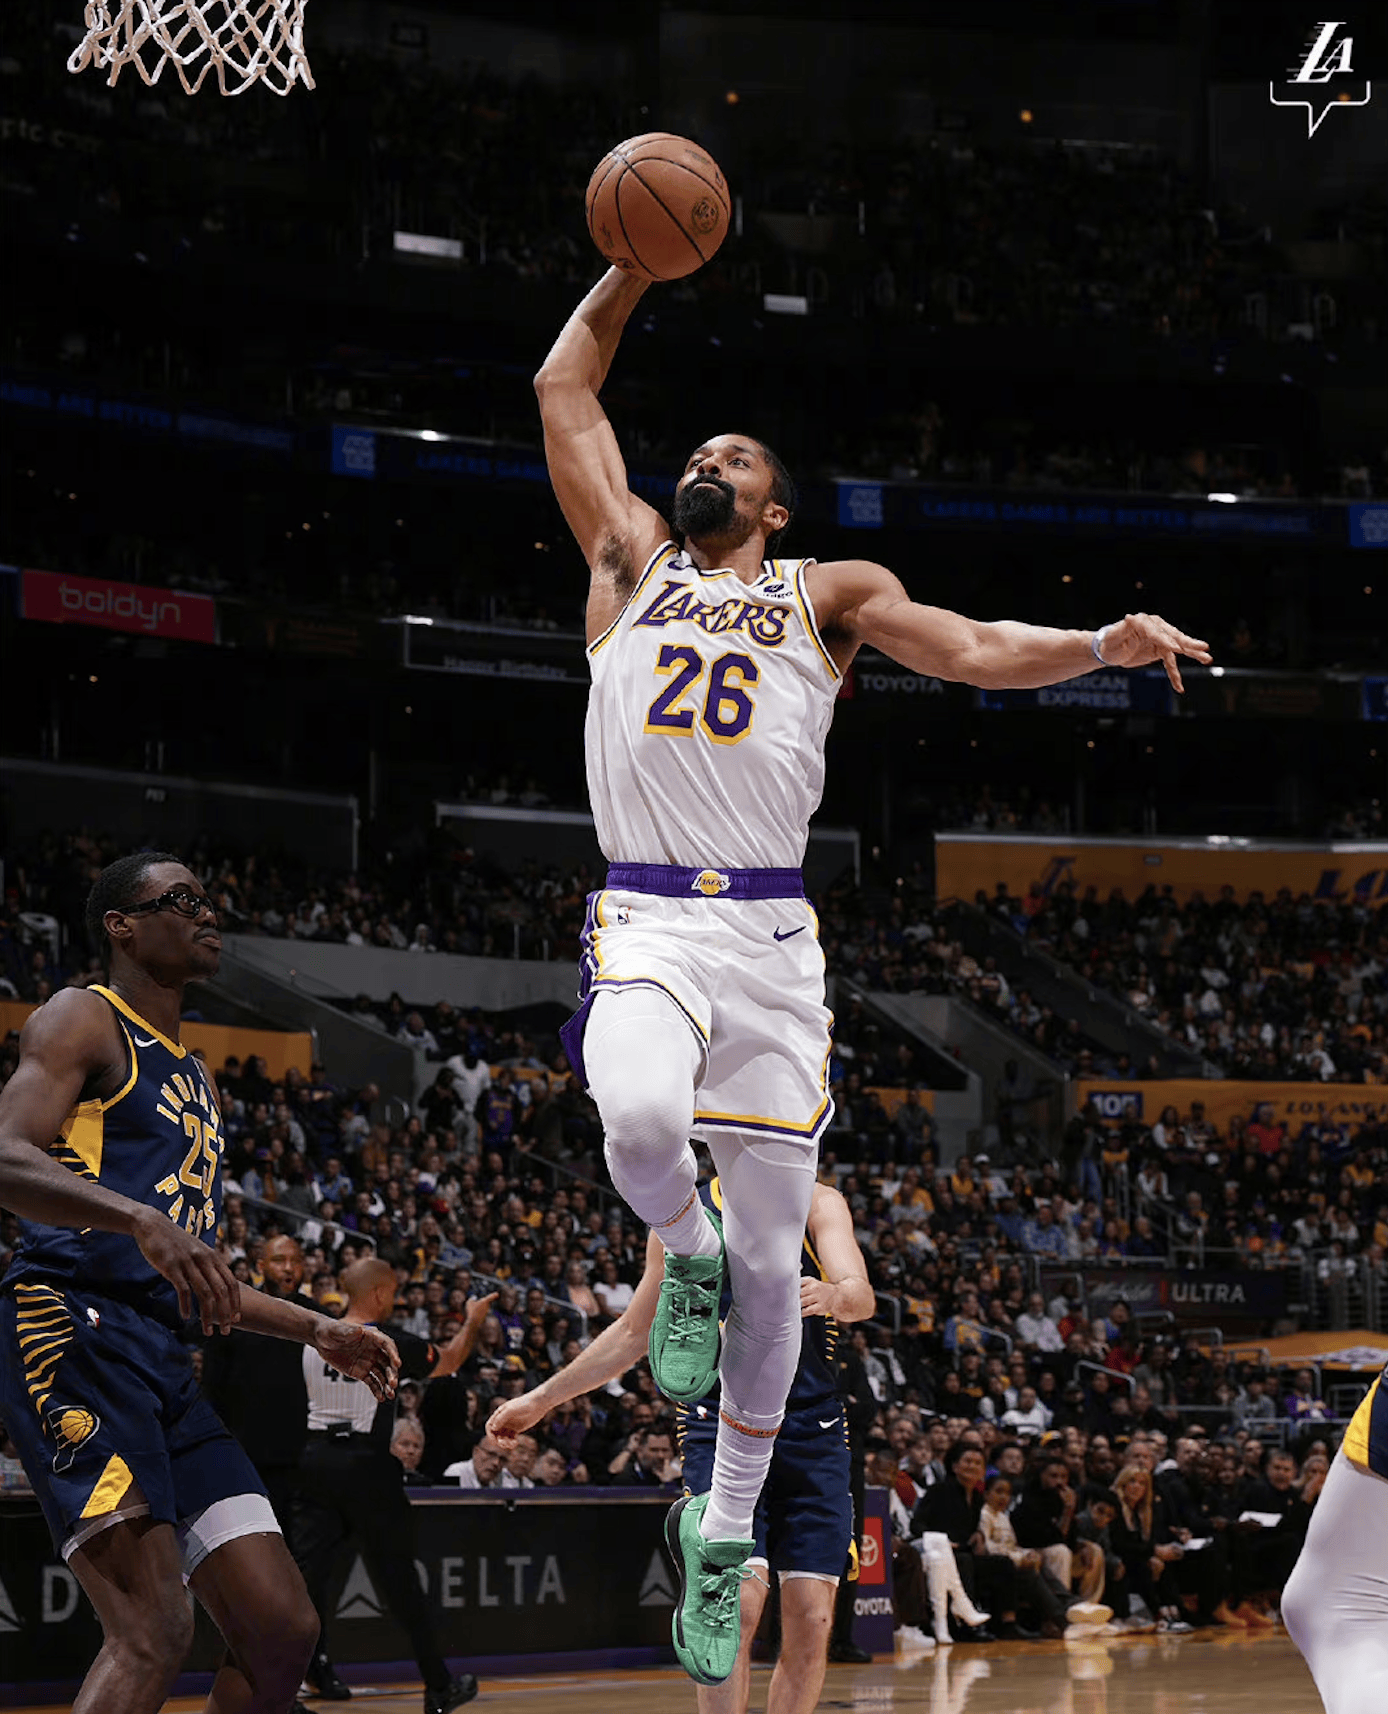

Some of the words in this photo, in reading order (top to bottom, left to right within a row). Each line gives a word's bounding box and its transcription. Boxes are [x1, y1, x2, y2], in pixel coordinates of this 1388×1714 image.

[58, 580, 182, 631] boldyn
[631, 580, 792, 649] LAKERS
[643, 643, 761, 746] 26
[859, 673, 944, 694] TOYOTA
[1037, 688, 1131, 709] EXPRESS
[178, 1111, 218, 1199] 25
[154, 1173, 216, 1238] PACS
[1171, 1281, 1247, 1303] ULTRA
[853, 1596, 894, 1617] OYOTA
